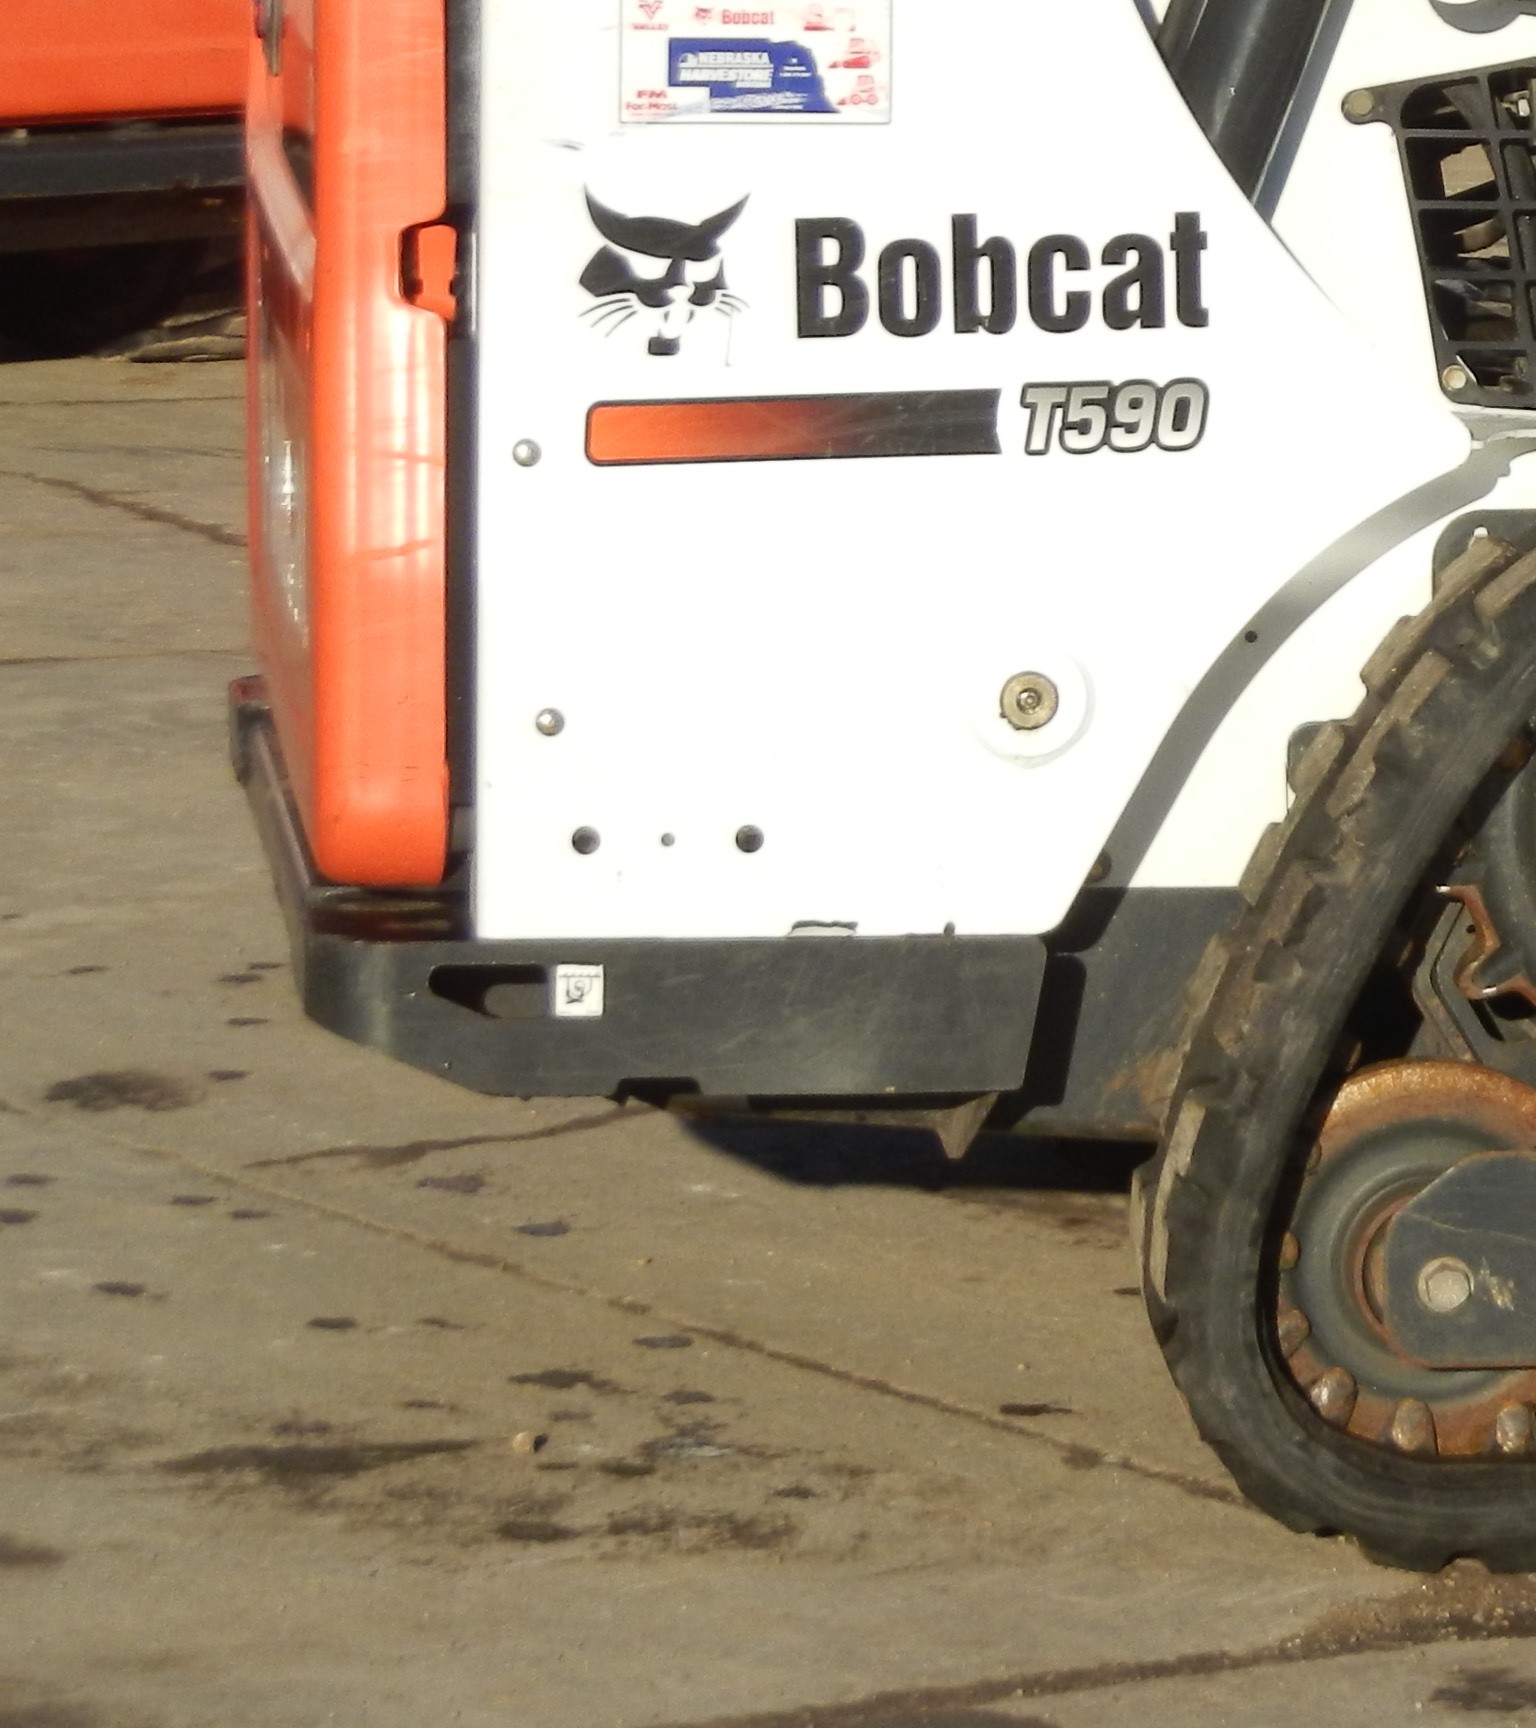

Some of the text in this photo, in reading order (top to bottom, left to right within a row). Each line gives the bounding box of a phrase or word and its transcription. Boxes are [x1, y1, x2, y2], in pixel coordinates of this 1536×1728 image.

[721, 9, 774, 25] Bobcat
[697, 52, 771, 65] NEBRASKA
[792, 211, 1210, 339] Bobcat
[1020, 377, 1210, 456] T590
